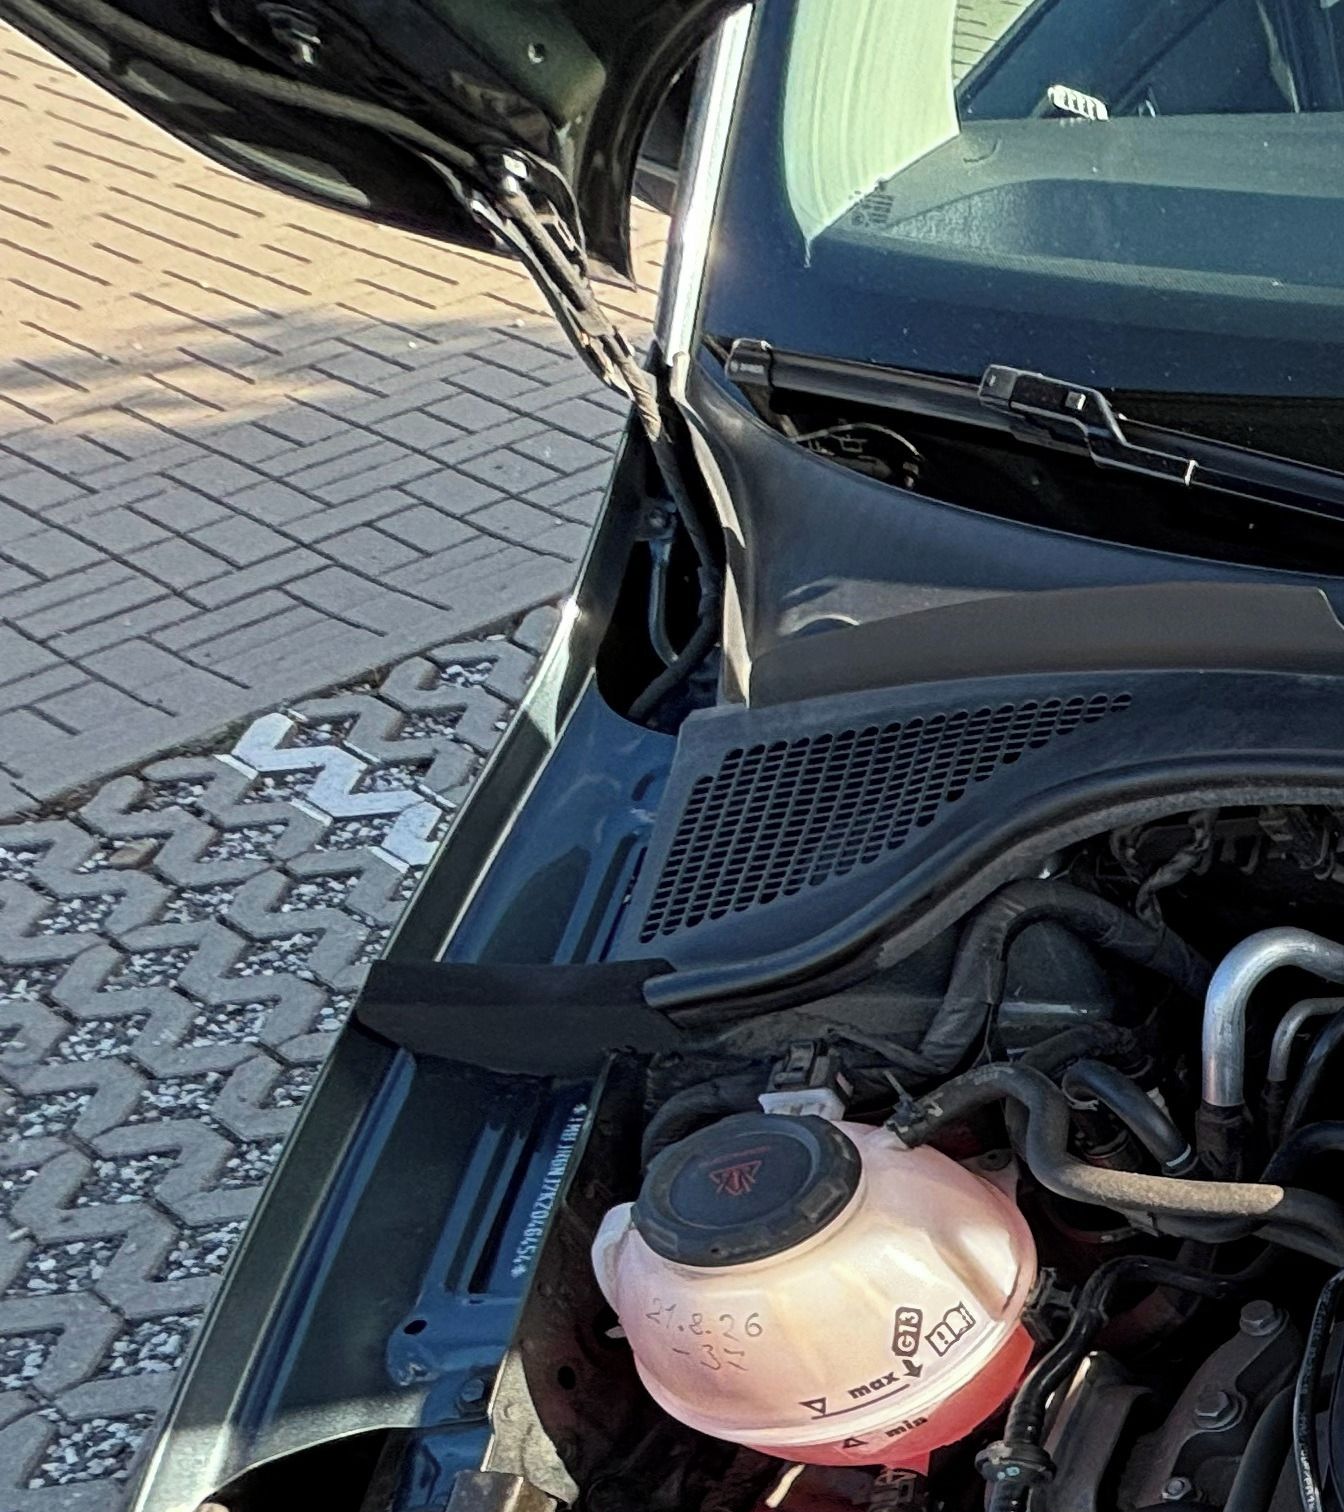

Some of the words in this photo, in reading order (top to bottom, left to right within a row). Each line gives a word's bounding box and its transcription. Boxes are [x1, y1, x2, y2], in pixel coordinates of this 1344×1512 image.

[898, 1309, 920, 1352] G13
[848, 1371, 901, 1399] max
[885, 1415, 928, 1438] min
